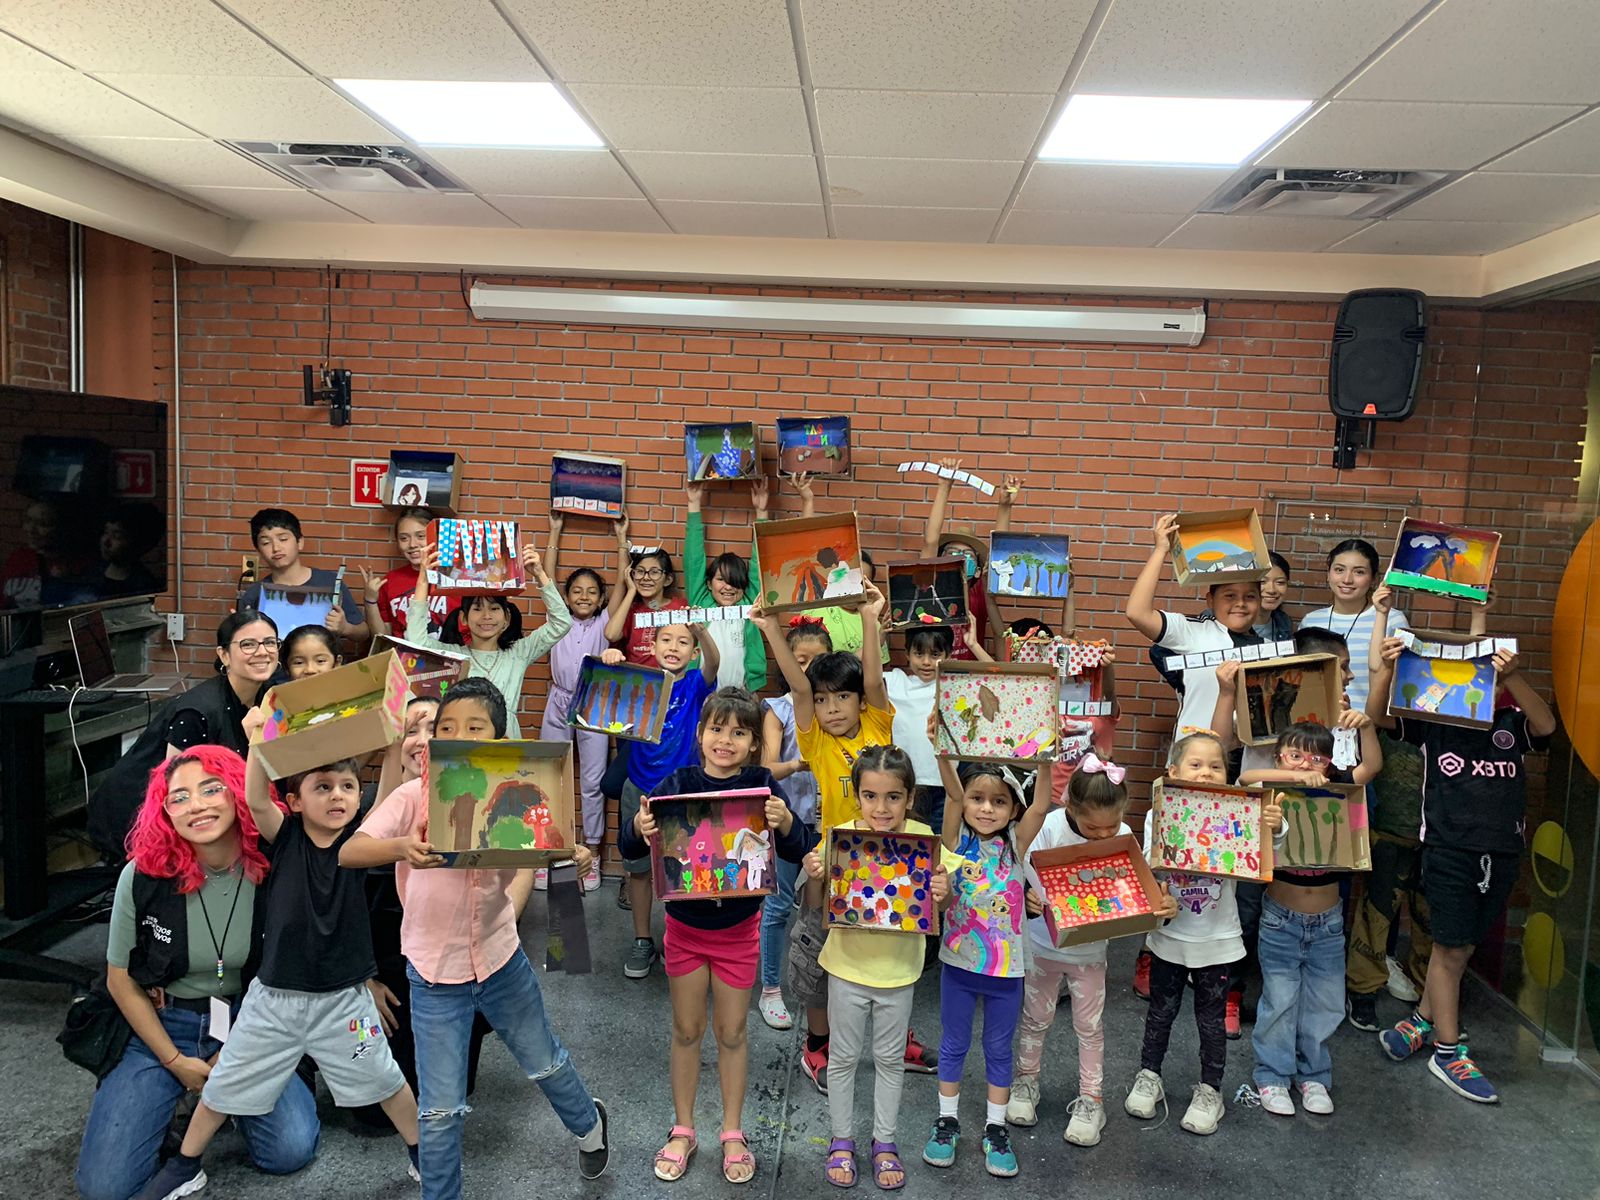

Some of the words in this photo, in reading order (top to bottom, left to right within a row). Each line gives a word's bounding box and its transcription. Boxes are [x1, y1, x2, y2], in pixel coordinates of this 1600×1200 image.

[390, 594, 447, 617] FAIA
[1471, 760, 1516, 778] XBTO
[1181, 888, 1209, 897] CAMILA
[1191, 900, 1202, 914] 4
